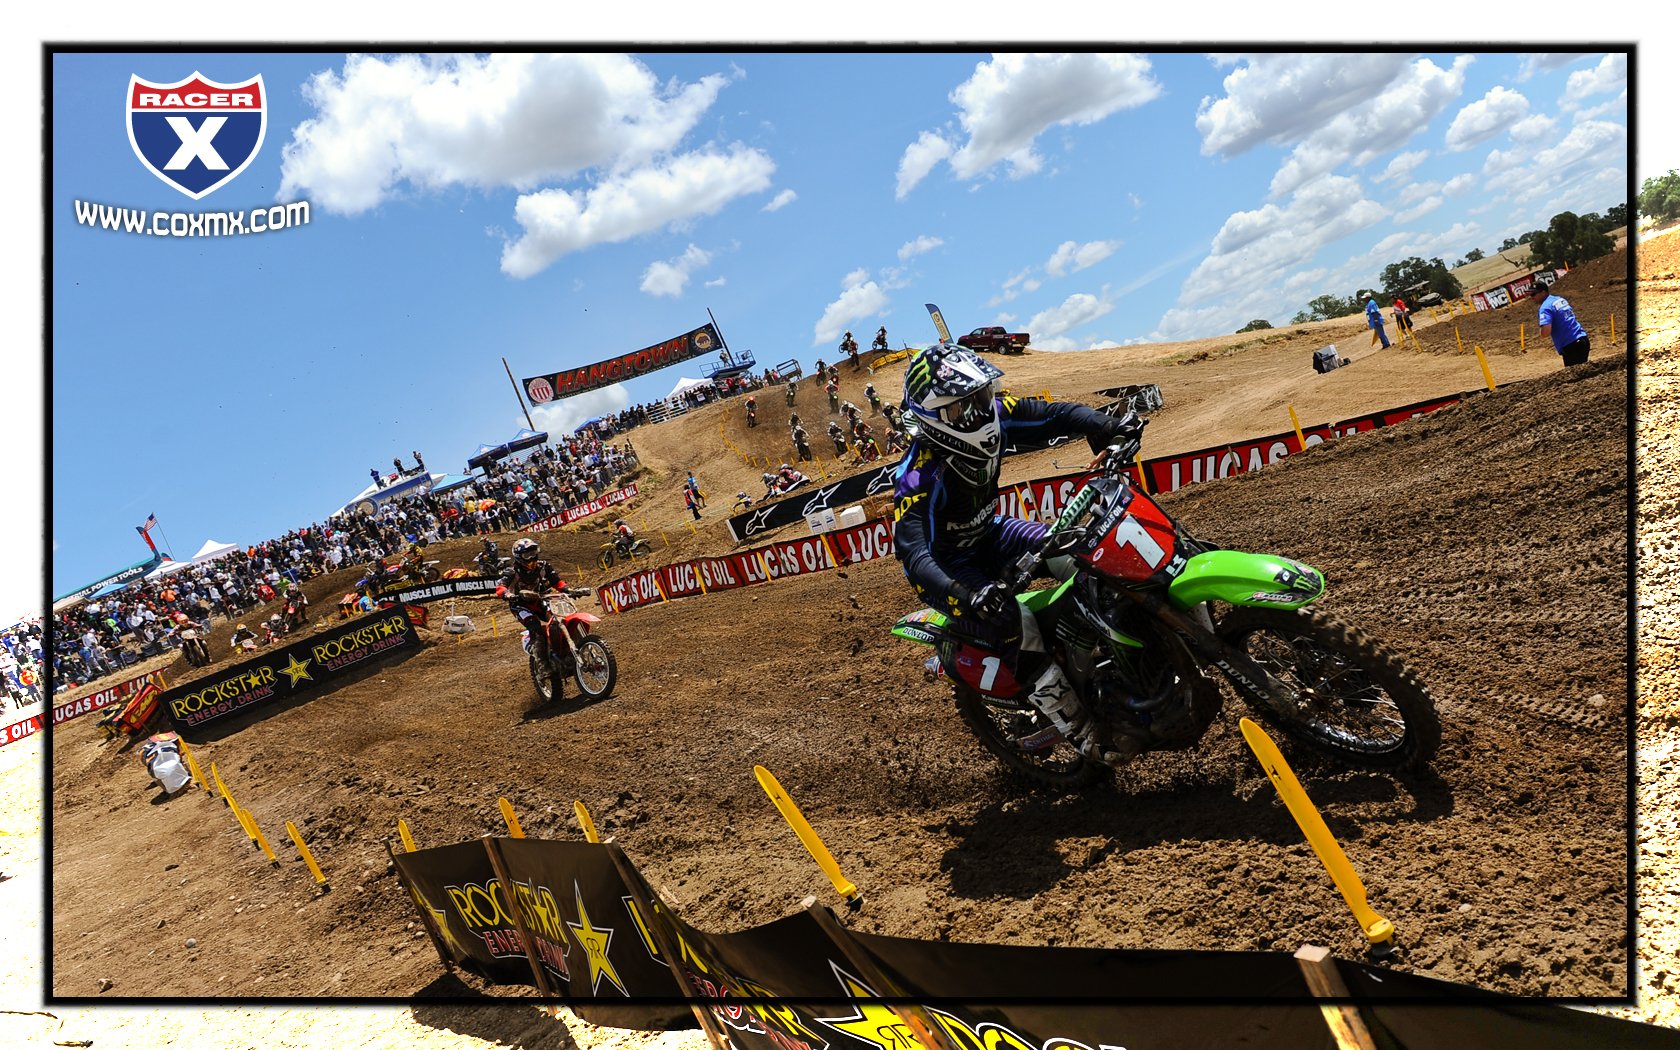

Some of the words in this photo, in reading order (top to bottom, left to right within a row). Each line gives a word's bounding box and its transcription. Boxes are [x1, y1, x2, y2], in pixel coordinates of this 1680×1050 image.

[556, 337, 689, 395] HANGTOWN
[605, 490, 624, 505] LUCAS
[624, 485, 637, 497] OIL
[566, 505, 590, 520] LUCAS
[1098, 514, 1117, 537] LUCAS
[1112, 505, 1125, 518] OIL
[1115, 514, 1166, 570] 1
[91, 577, 119, 592] POWER
[119, 566, 144, 580] TOOLS
[711, 560, 735, 585] OIL
[399, 588, 431, 602] MUSCLE
[432, 584, 453, 597] MILK
[456, 580, 484, 592] MUSCLE
[312, 616, 407, 664] ROCKSTAR
[903, 627, 935, 643] DUNLOP
[326, 646, 369, 671] ENERGY
[371, 634, 404, 652] DRINK
[979, 656, 1000, 691] 1
[95, 688, 118, 708] OIL
[171, 666, 276, 718] ROCKSTAR
[186, 699, 234, 725] ENERGY
[237, 685, 273, 705] DRINK
[11, 719, 36, 739] OIL
